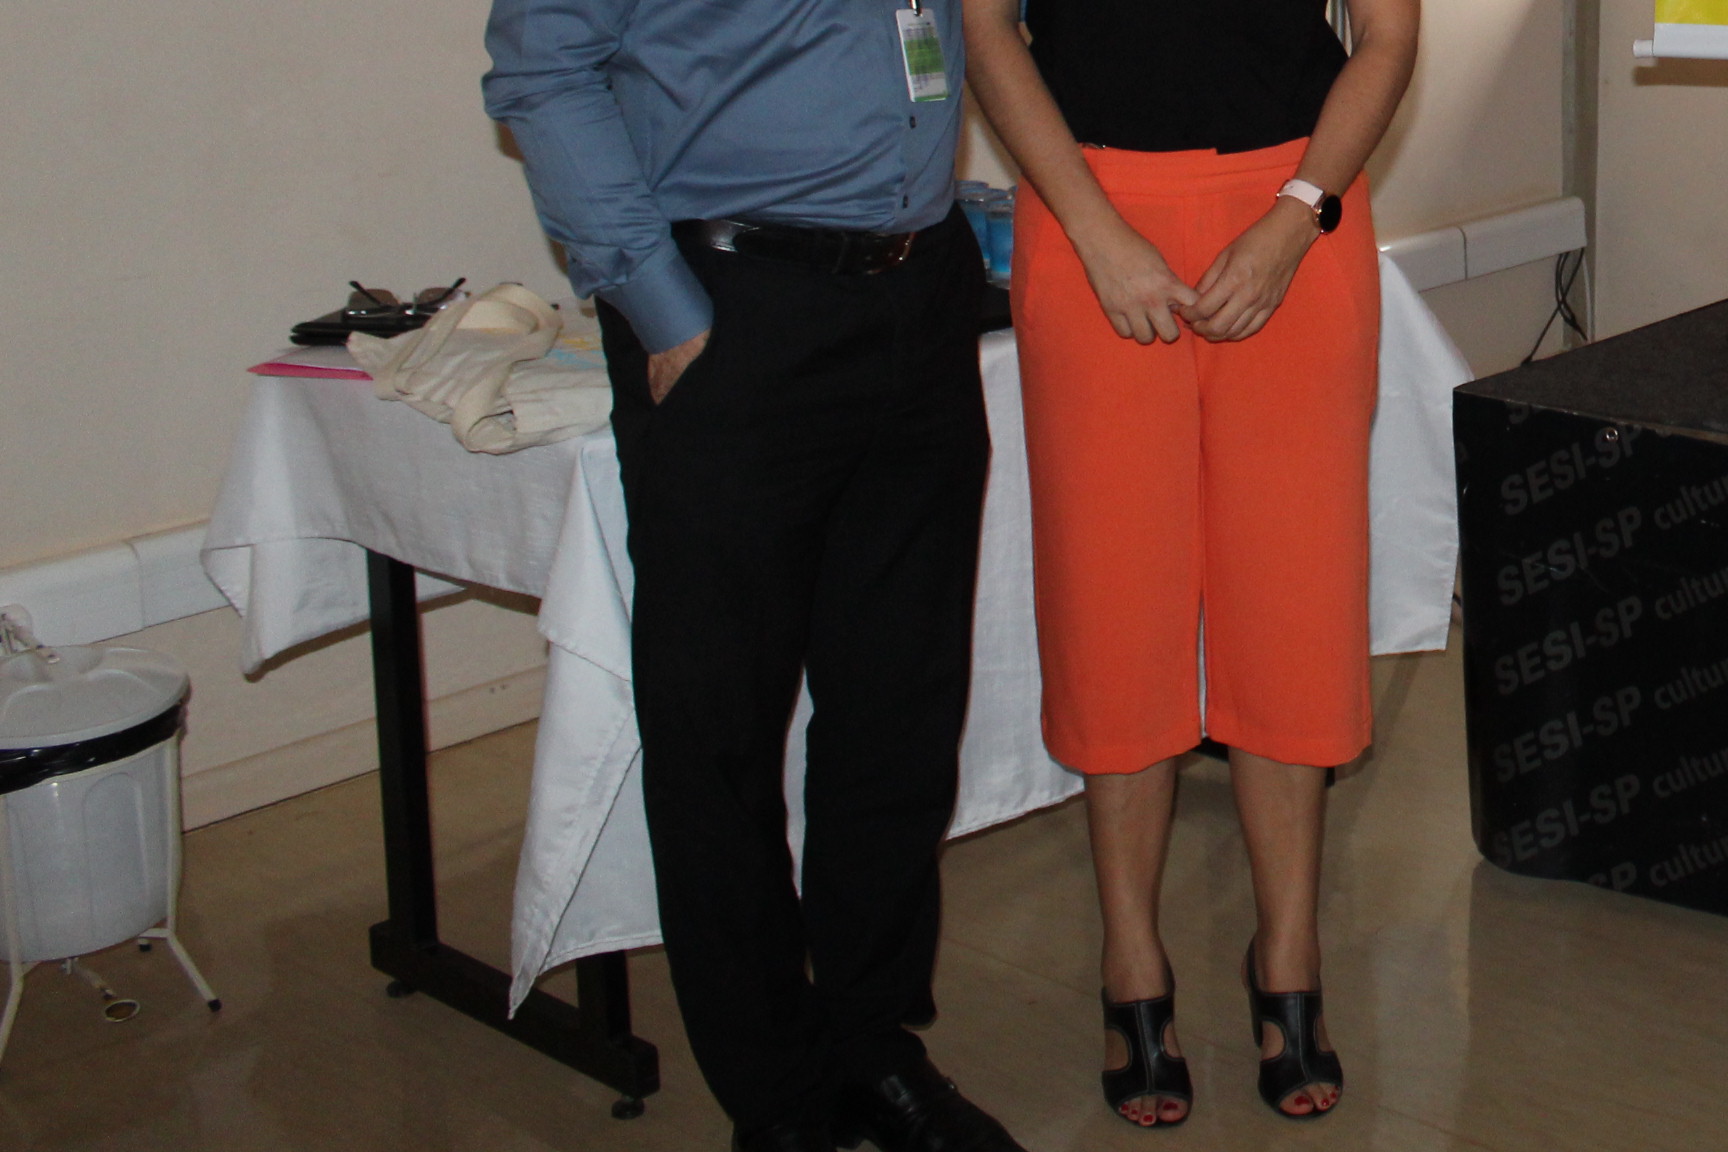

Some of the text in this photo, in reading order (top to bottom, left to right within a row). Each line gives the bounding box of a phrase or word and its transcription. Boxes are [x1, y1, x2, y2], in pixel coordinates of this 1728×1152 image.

[1501, 425, 1641, 516] SESI-SP
[1496, 506, 1642, 606] SESI-SP
[1494, 596, 1643, 695] SESI-SP
[1492, 686, 1642, 783] SESI-SP
[1492, 774, 1640, 869] SESI-SP
